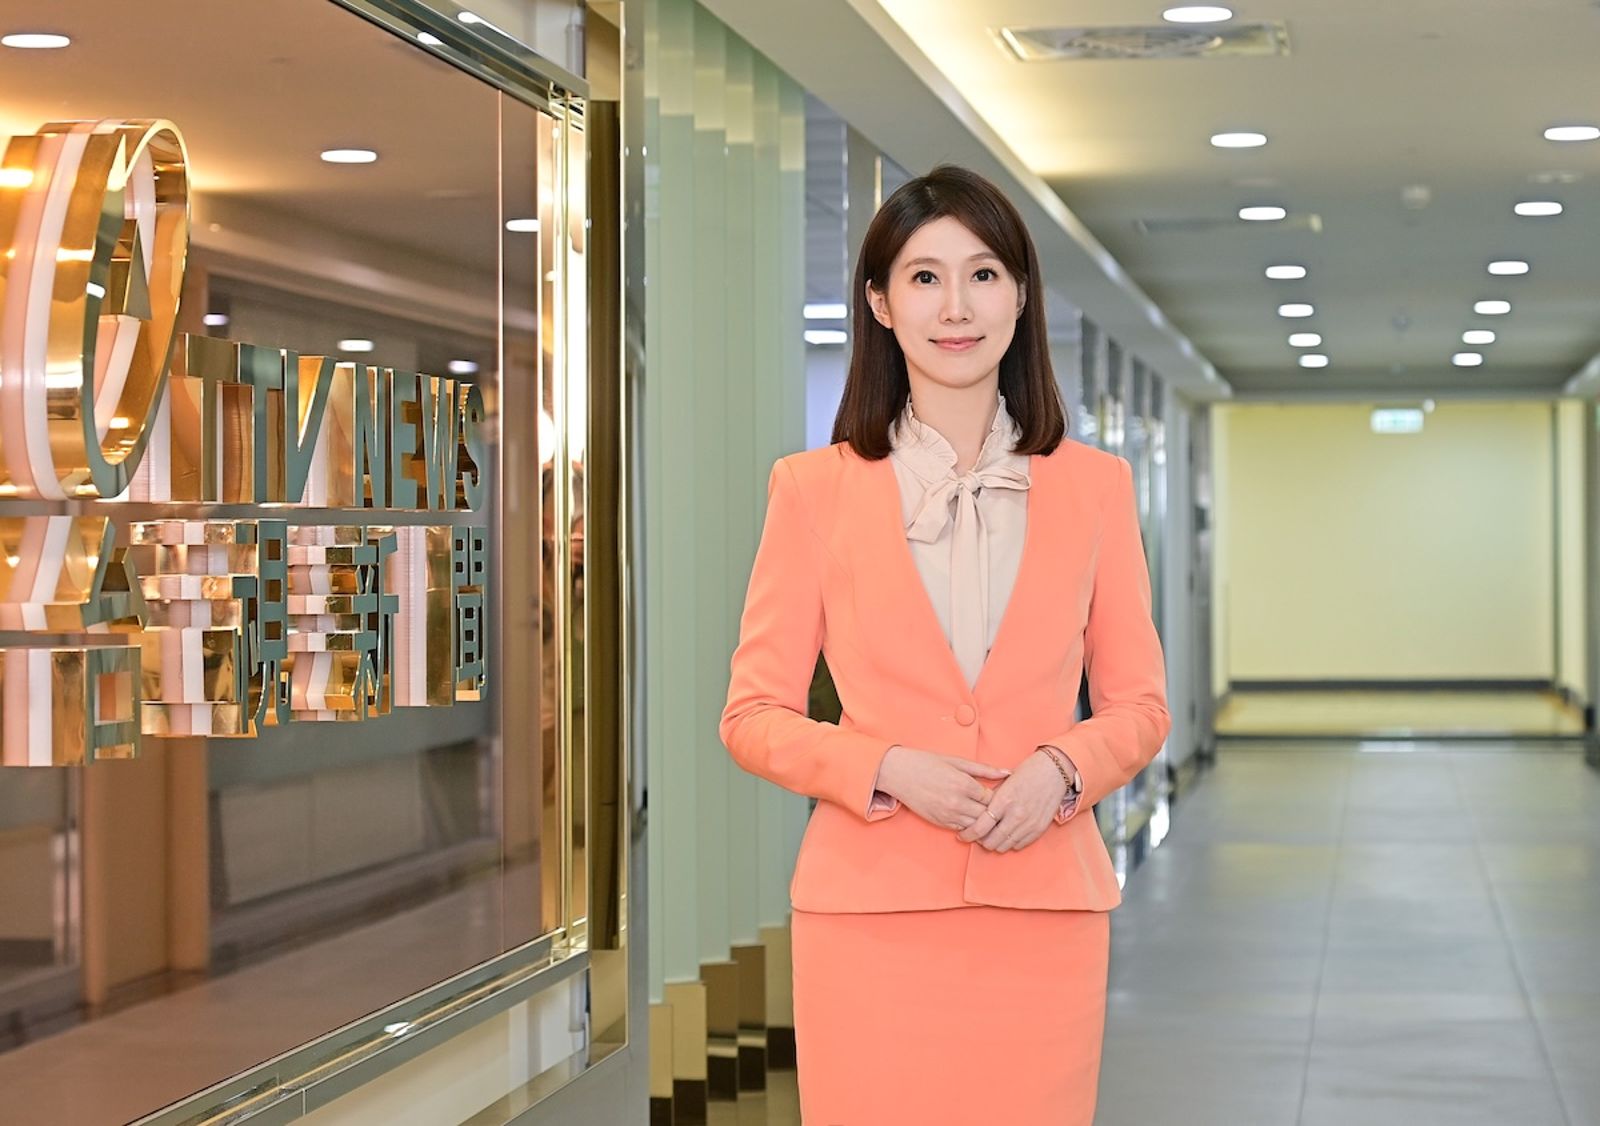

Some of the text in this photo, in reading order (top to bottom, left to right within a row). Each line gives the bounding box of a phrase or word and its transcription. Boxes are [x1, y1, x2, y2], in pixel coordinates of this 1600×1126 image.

[186, 332, 486, 512] TTV NEWS
[80, 516, 488, 767] 台視新聞
